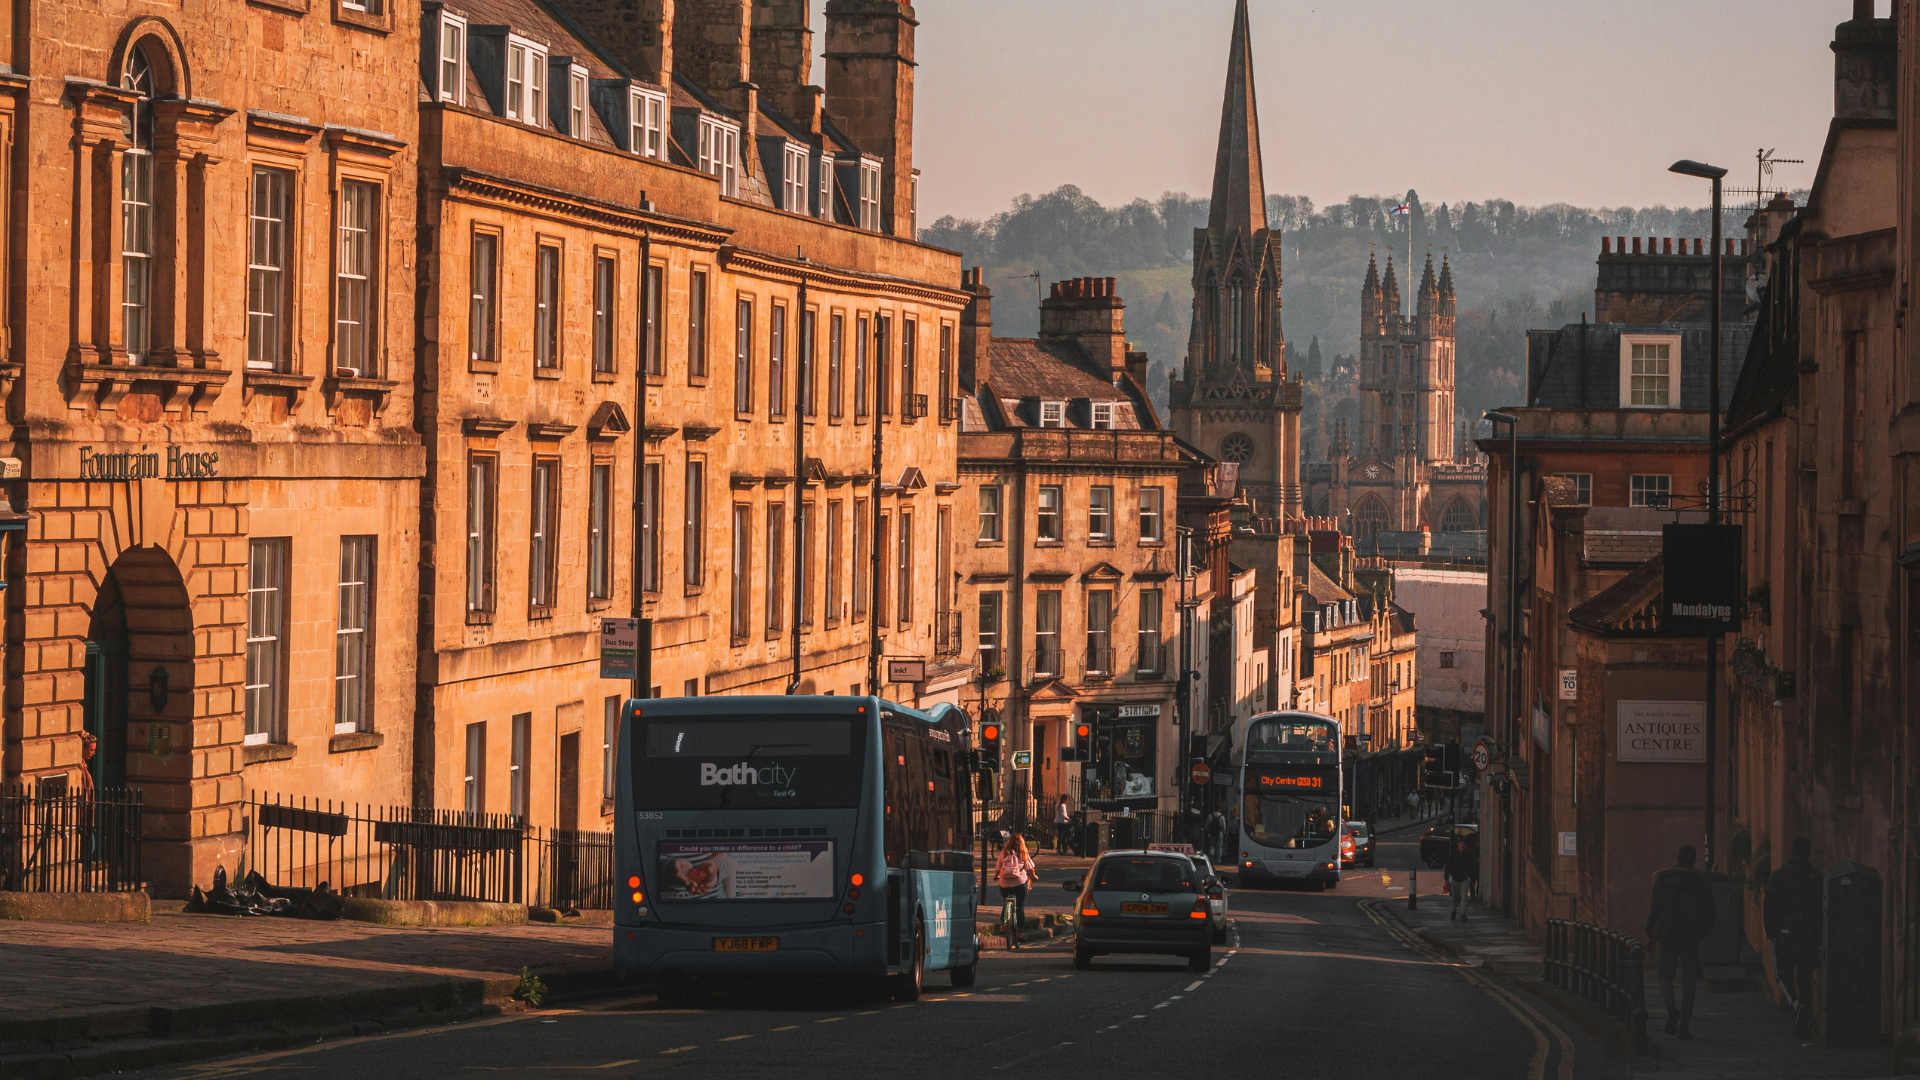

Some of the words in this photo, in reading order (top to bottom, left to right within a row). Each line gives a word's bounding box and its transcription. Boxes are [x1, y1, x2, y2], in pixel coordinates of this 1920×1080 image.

[79, 444, 159, 479] Fountain
[166, 445, 219, 477] House
[1672, 602, 1731, 618] Mandalyns
[618, 639, 633, 648] Stop
[1563, 680, 1575, 689] TO
[1124, 705, 1154, 716] STATION
[1624, 723, 1700, 736] ANTIQUES
[1631, 738, 1693, 751] CENTRE
[1475, 751, 1487, 765] 20
[1261, 776, 1274, 786] City
[1275, 776, 1296, 785] Centre
[1311, 777, 1321, 788] 31
[639, 811, 664, 820] 53852
[720, 938, 748, 949] YJ68
[751, 938, 772, 949] FWP
